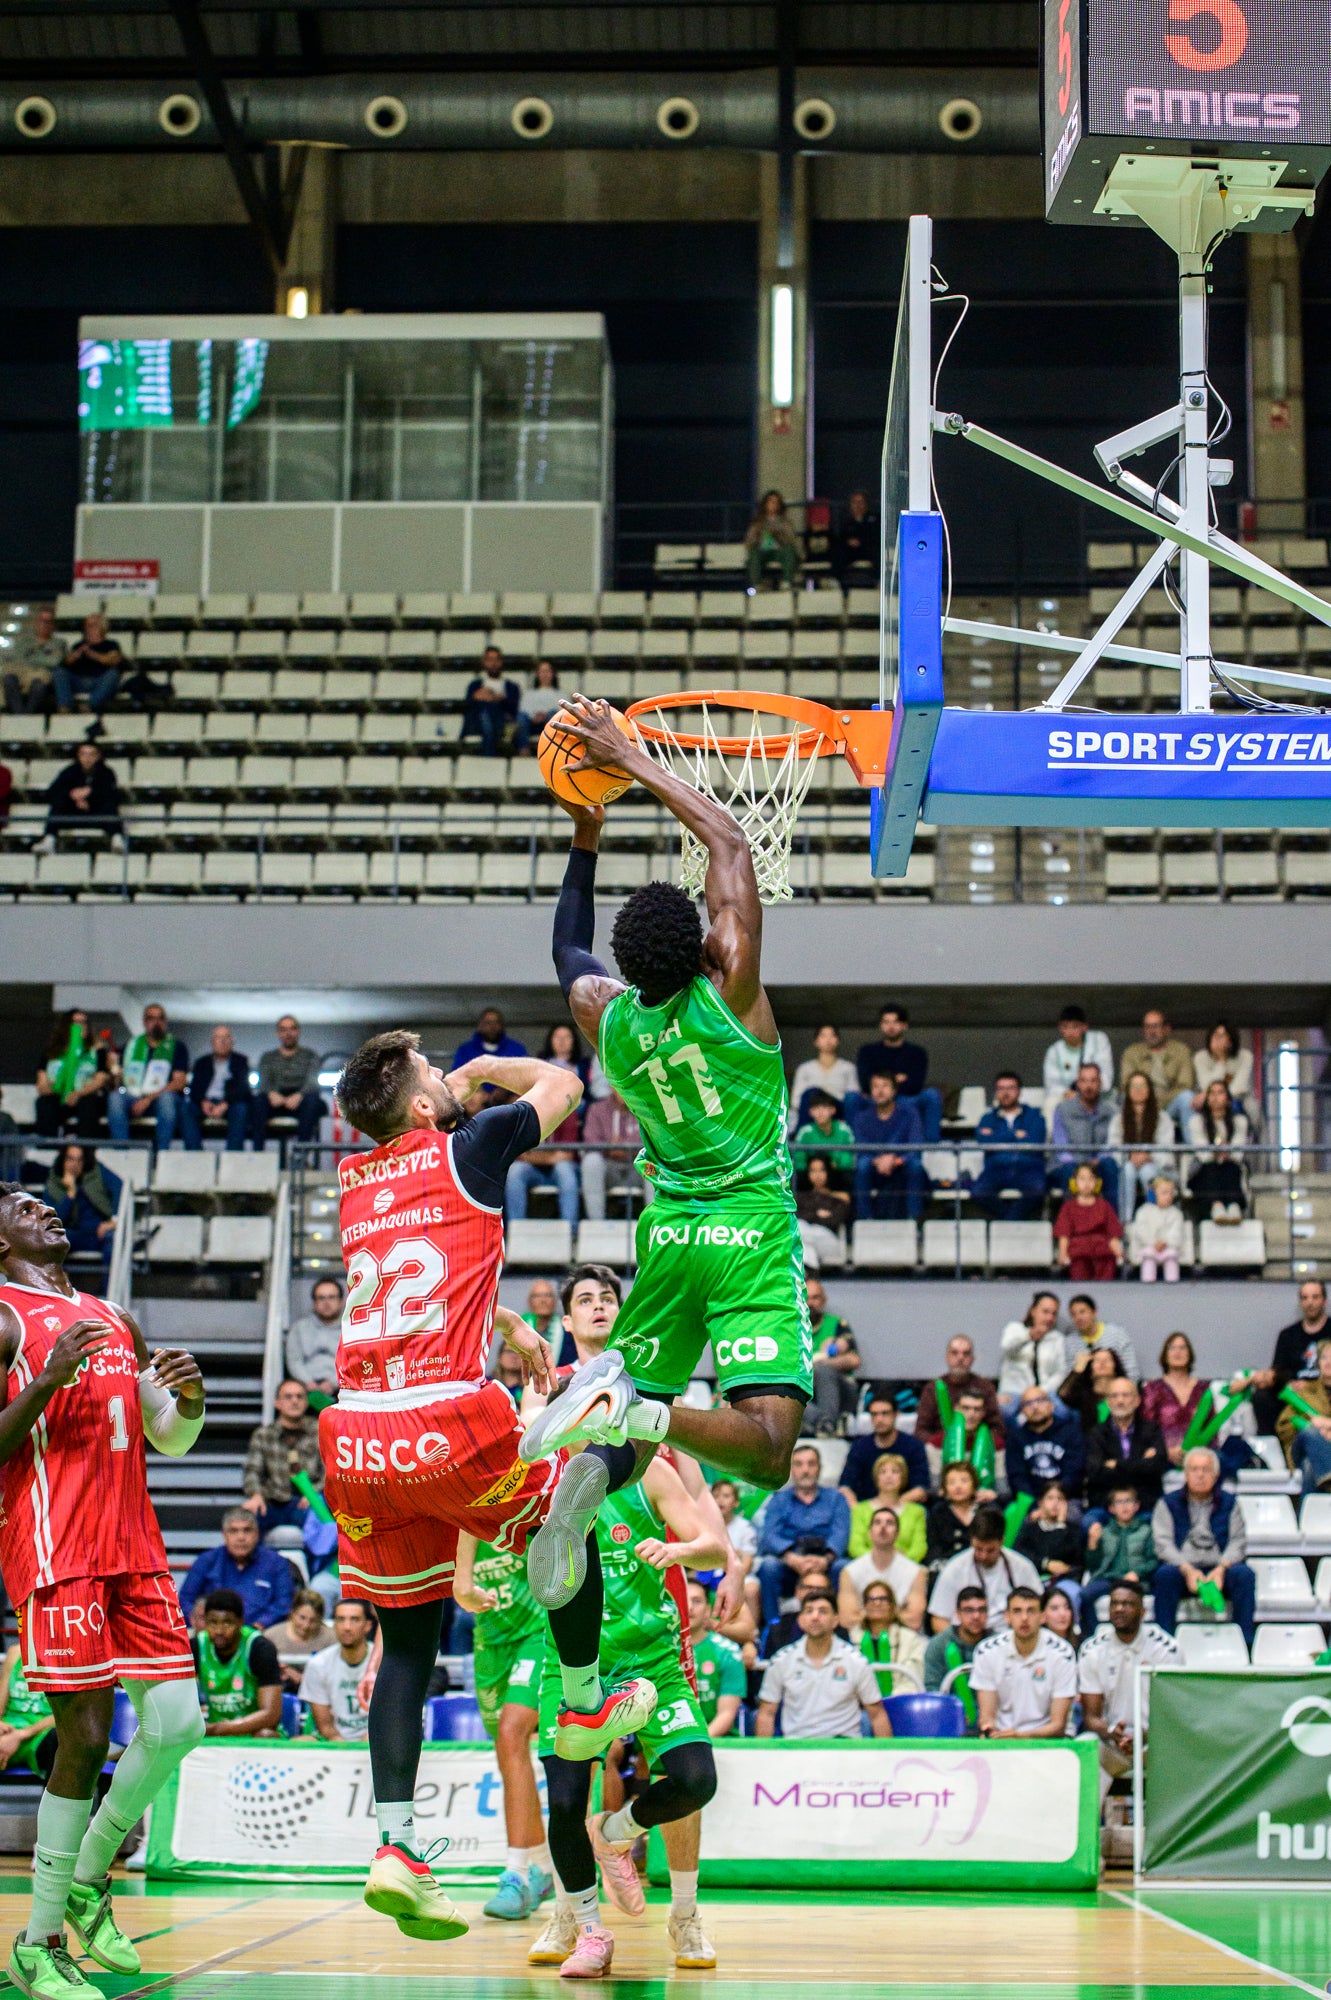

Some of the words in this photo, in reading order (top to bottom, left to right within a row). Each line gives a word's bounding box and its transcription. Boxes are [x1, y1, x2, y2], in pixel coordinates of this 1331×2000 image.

[1164, 0, 1248, 72] 5
[1124, 86, 1301, 129] AMICS
[1048, 731, 1183, 760] SPORT
[631, 1042, 724, 1125] 11
[341, 1206, 444, 1248] NTERMAQUINAS
[342, 1235, 449, 1348] 22
[716, 1336, 779, 1367] CCD
[108, 1395, 129, 1452] 1
[336, 1473, 386, 1485] PESCADOS
[754, 1782, 956, 1808] Mondent
[1256, 1810, 1331, 1860] hu
